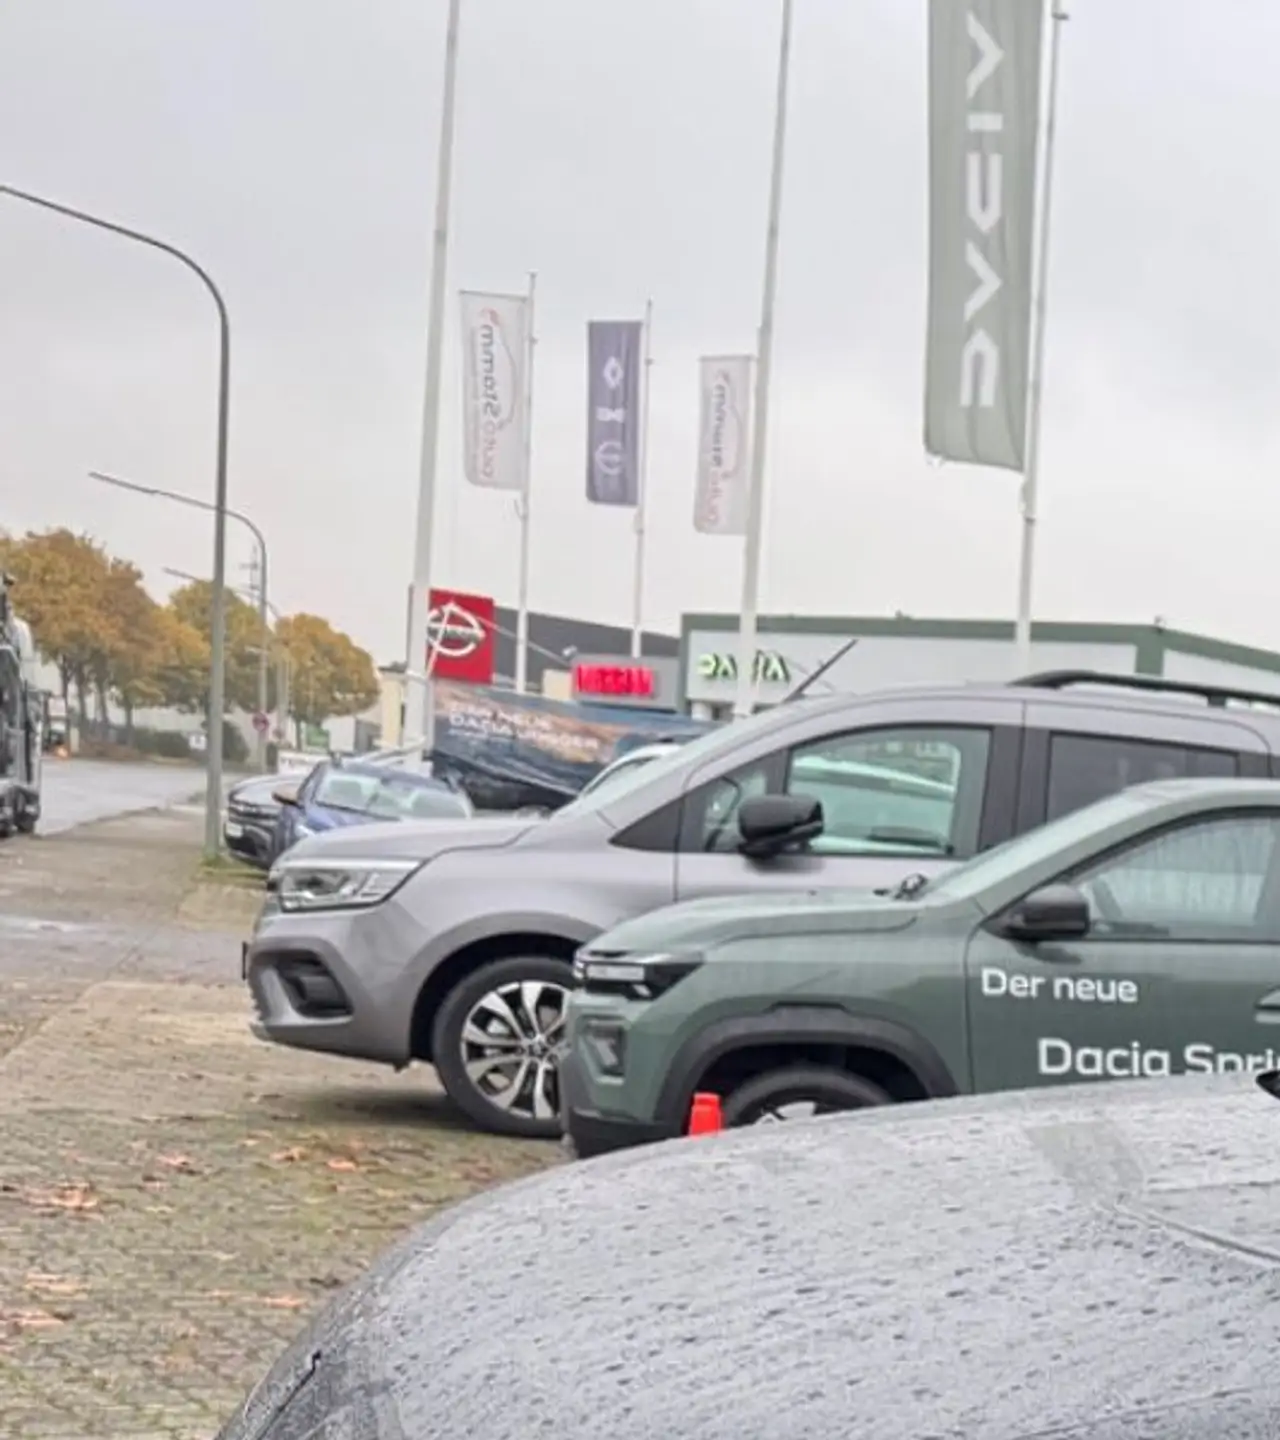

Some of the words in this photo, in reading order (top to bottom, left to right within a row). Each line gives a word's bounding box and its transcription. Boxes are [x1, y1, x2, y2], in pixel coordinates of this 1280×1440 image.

[981, 967, 1046, 997] Der
[1053, 976, 1138, 1003] neue
[1037, 1037, 1171, 1077] Dacia
